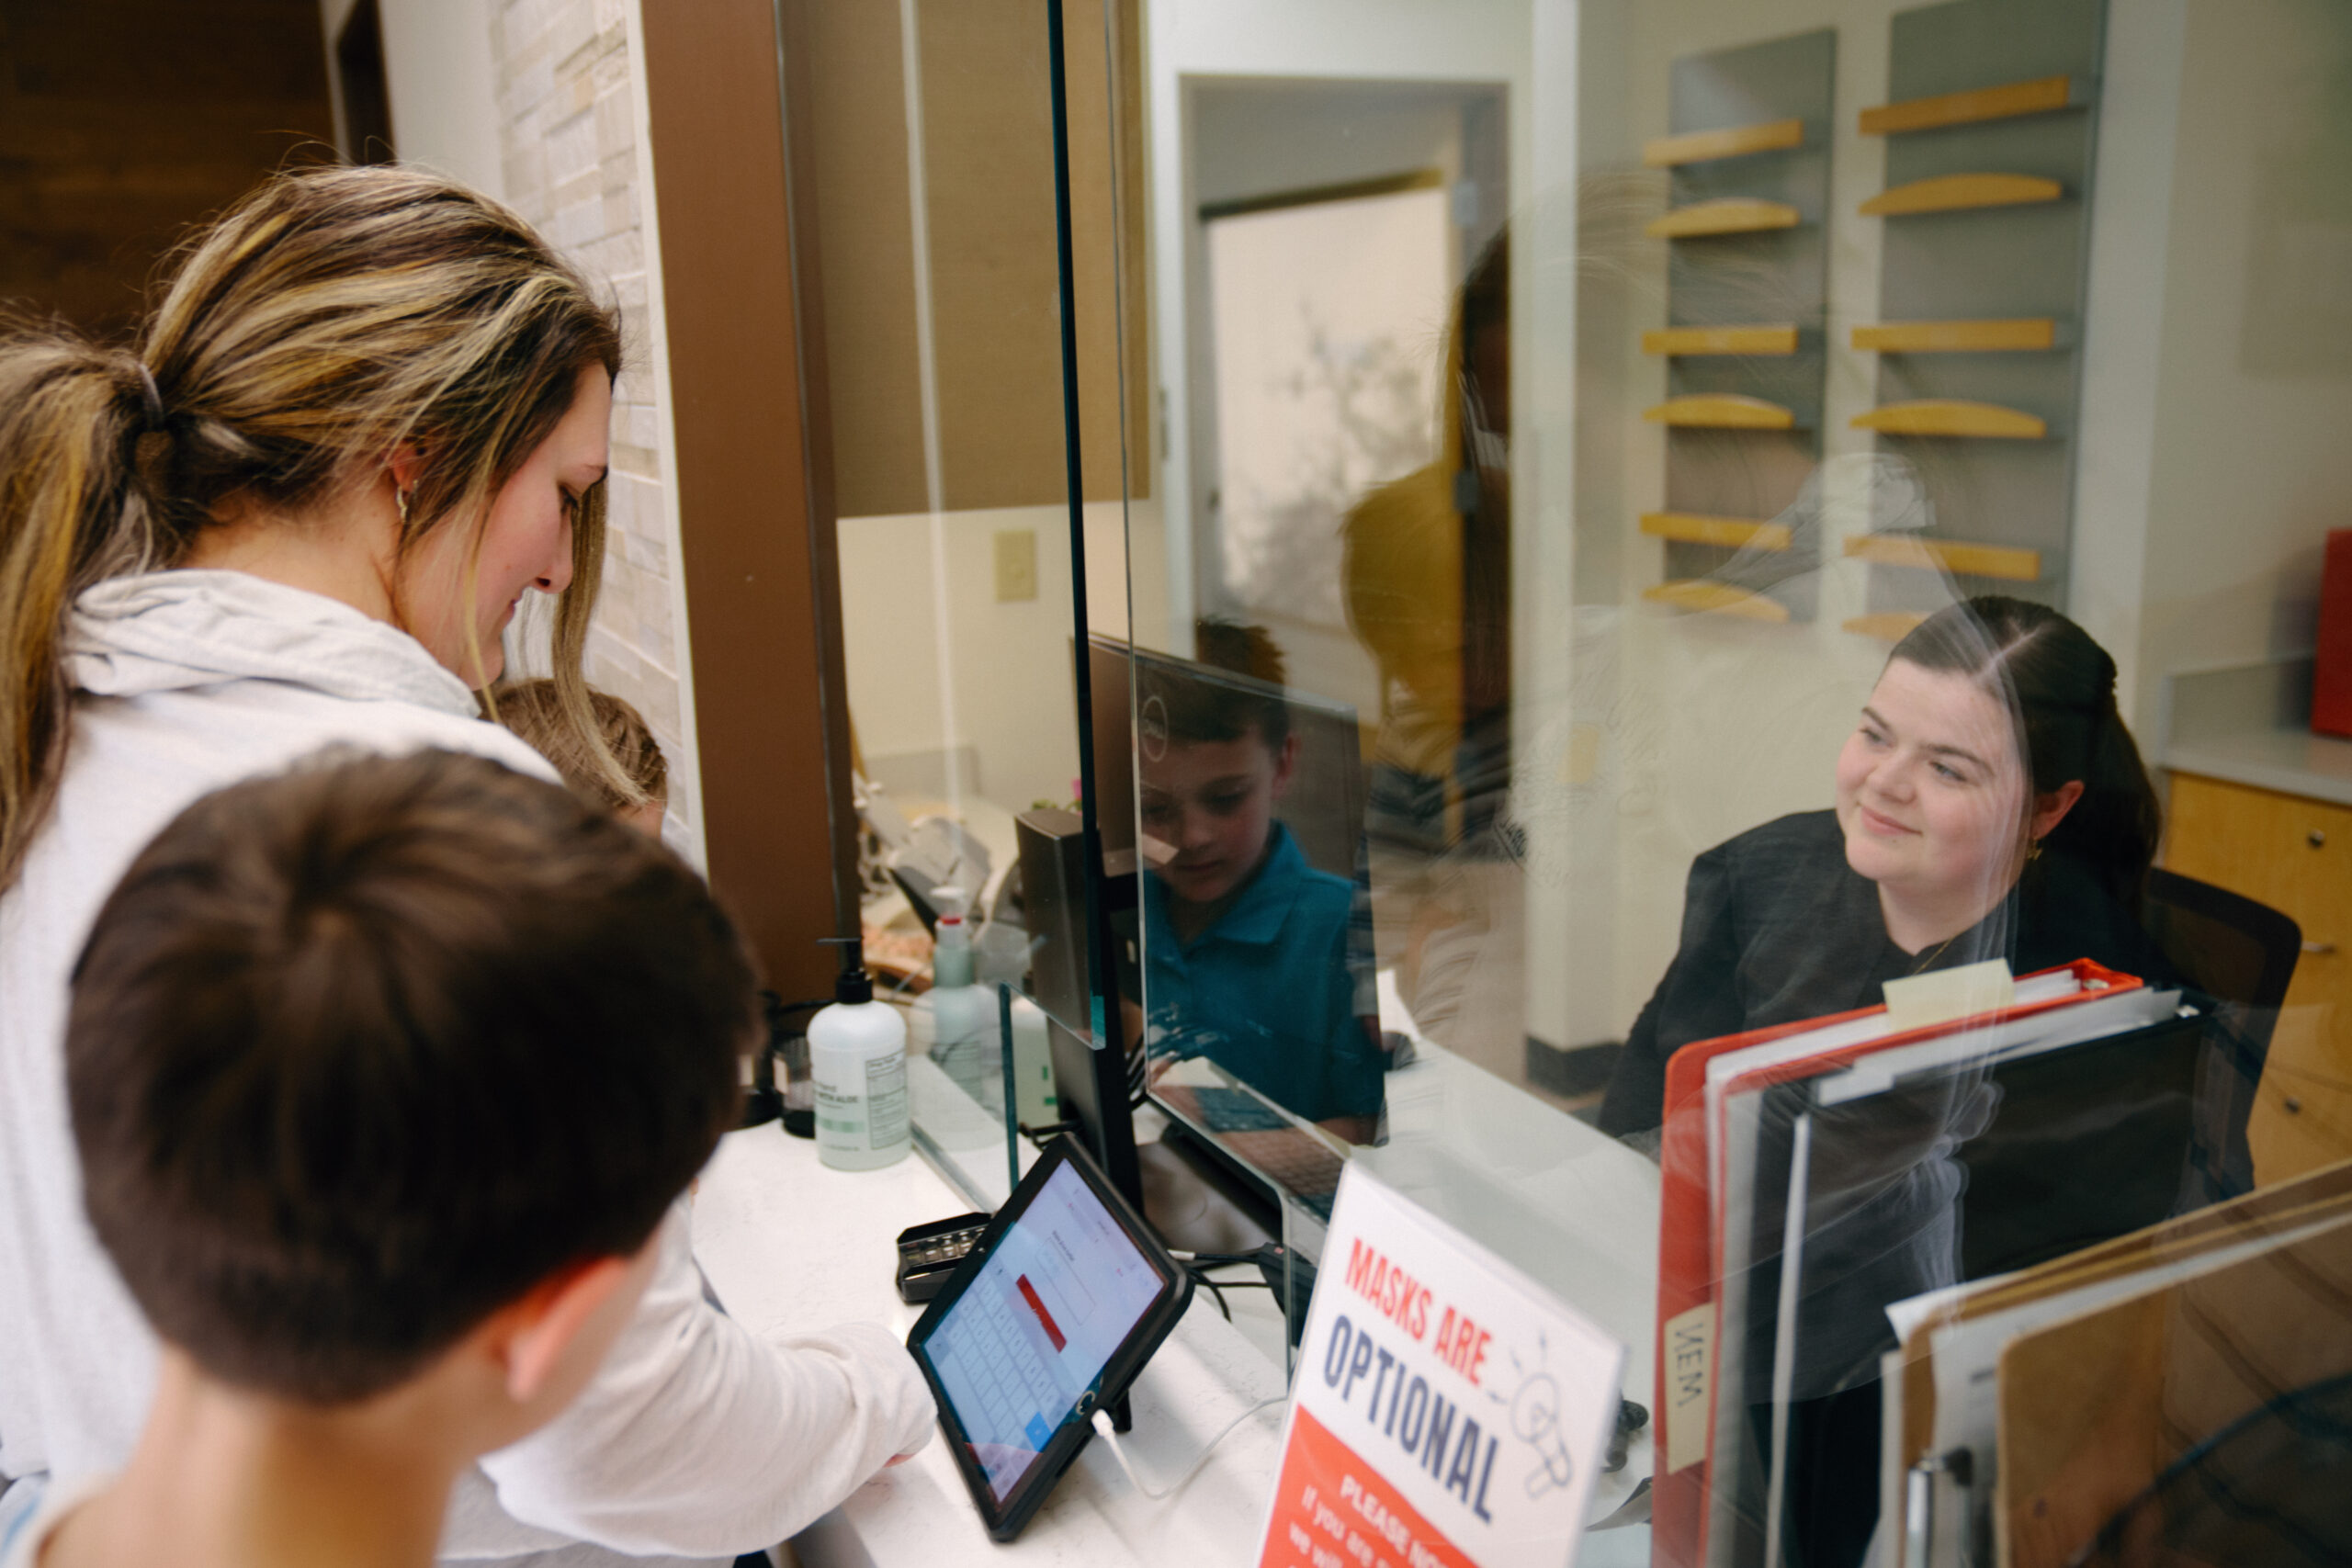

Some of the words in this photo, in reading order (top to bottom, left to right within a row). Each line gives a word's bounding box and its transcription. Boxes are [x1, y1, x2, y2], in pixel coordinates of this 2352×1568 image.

[1346, 1236, 1433, 1342] MASKS
[1434, 1305, 1493, 1386] ARE
[1324, 1314, 1500, 1525] OPTIONAL
[1313, 1500, 1346, 1541] you
[1346, 1530, 1374, 1568] are
[1340, 1473, 1410, 1556] PLEASE
